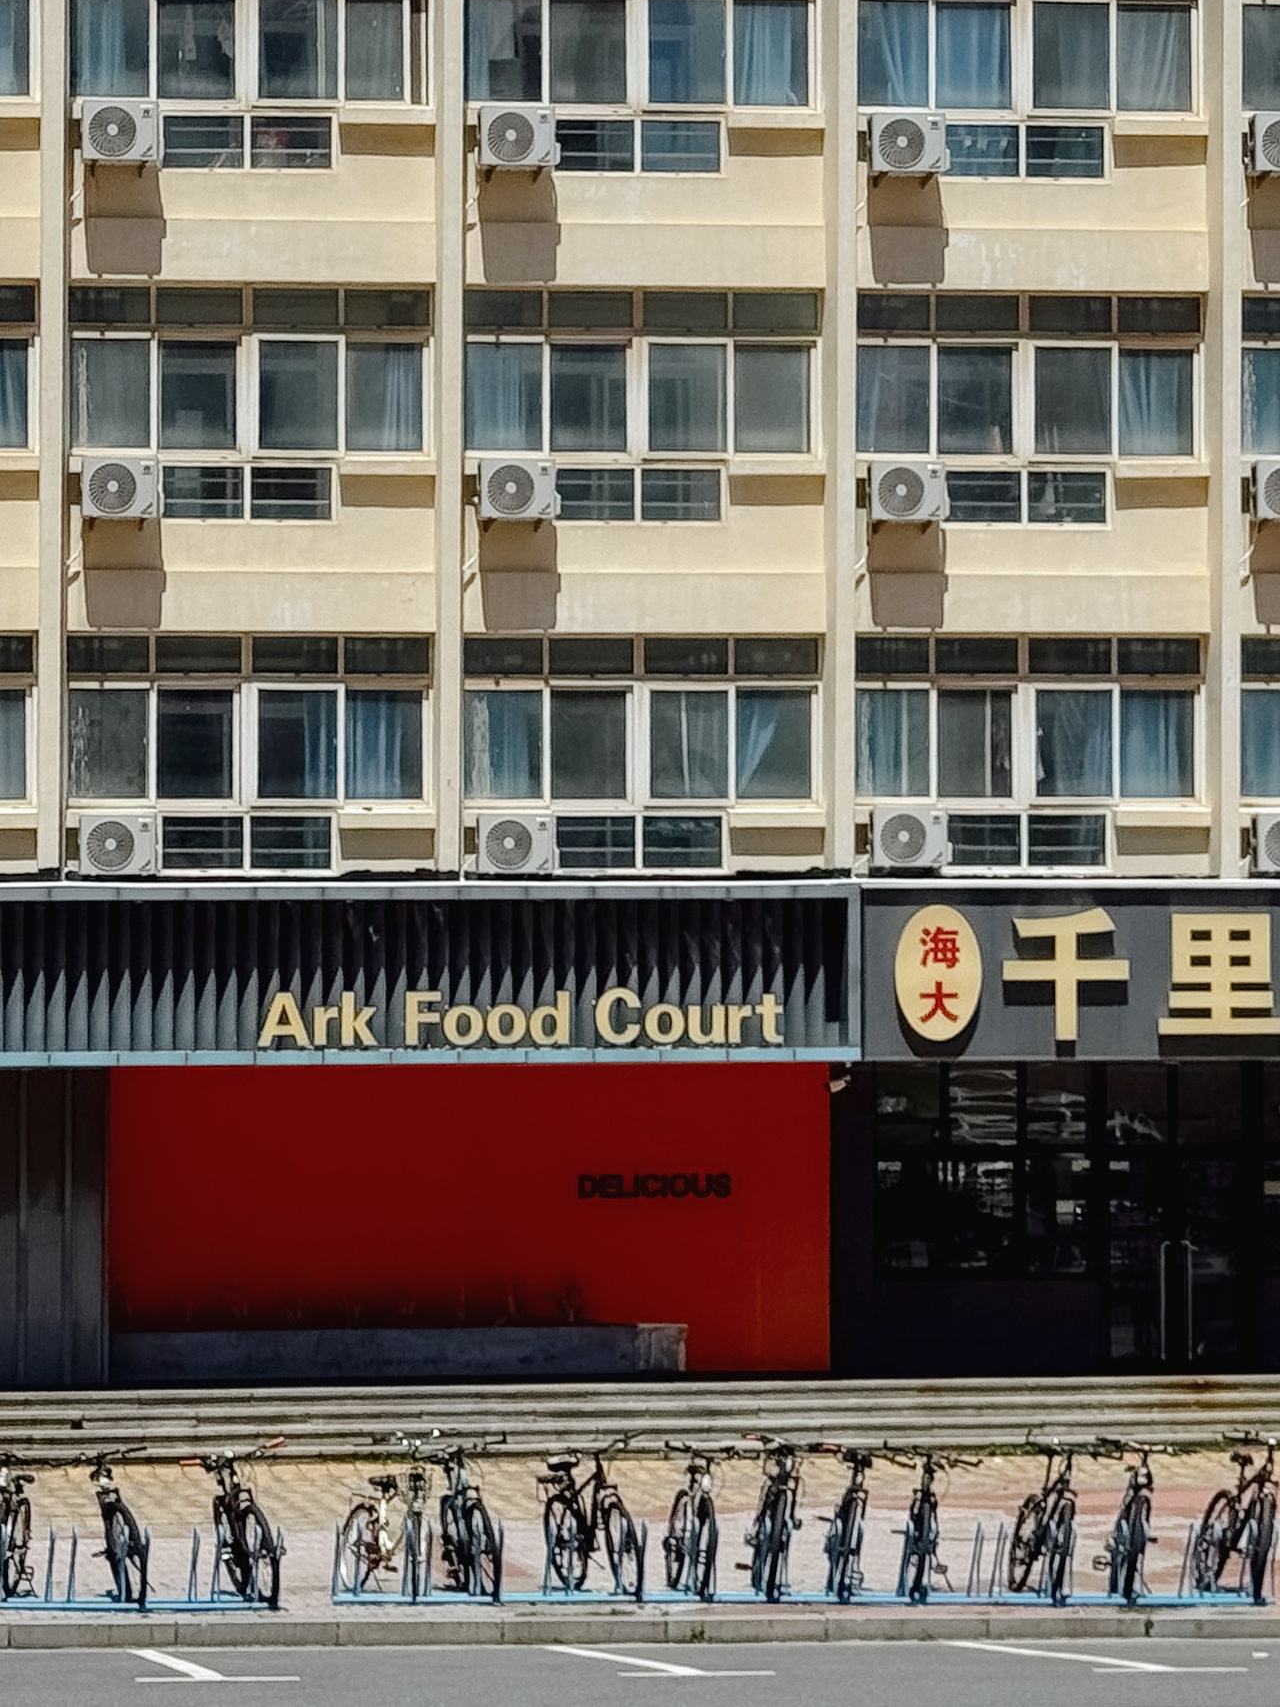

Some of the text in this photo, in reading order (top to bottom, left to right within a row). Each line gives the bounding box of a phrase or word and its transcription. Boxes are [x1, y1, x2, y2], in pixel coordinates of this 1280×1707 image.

[918, 925, 961, 1025] 海大
[257, 987, 784, 1047] Ark Food Court
[577, 1173, 732, 1199] DELICIOUS
